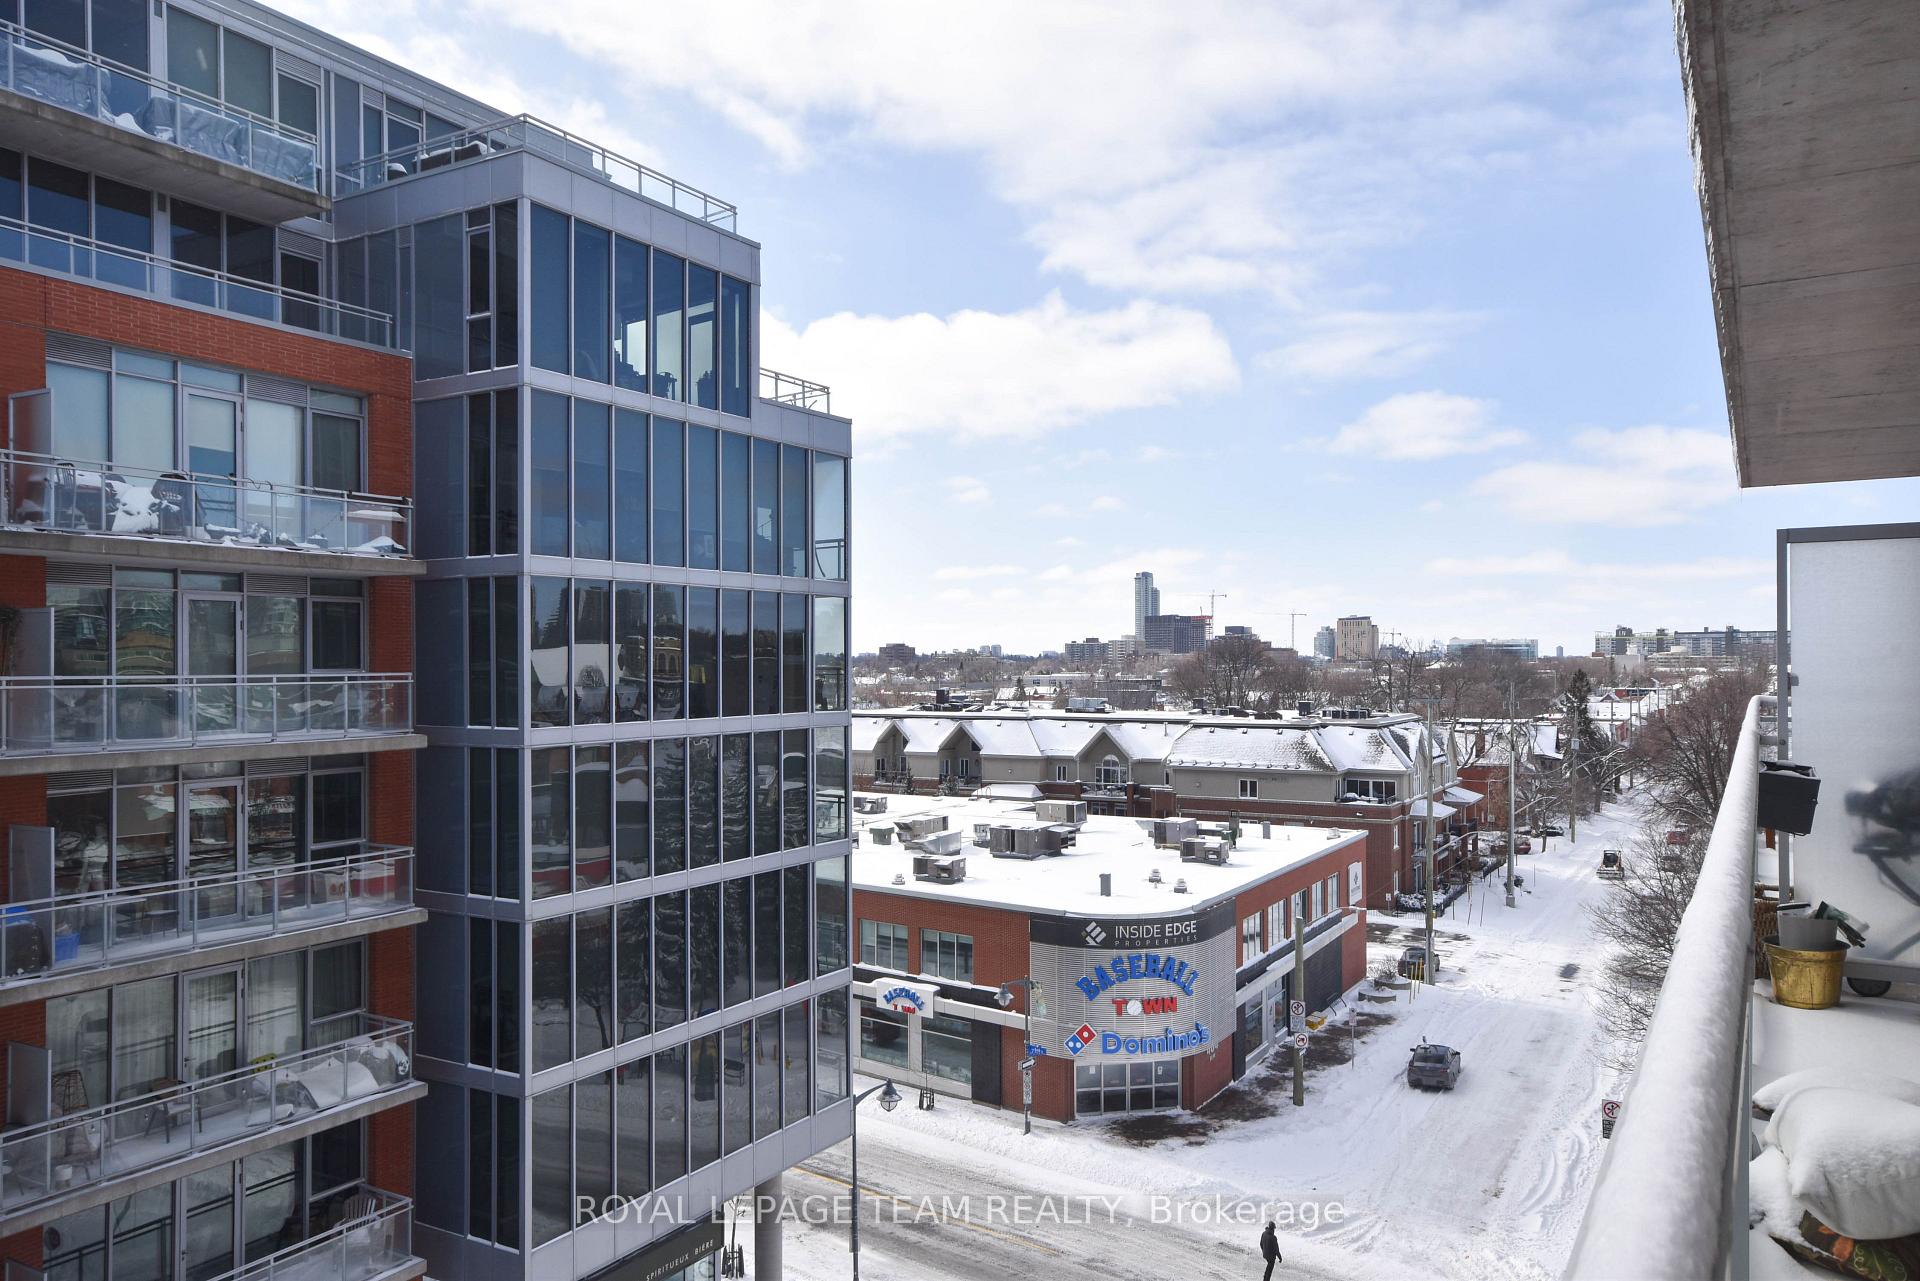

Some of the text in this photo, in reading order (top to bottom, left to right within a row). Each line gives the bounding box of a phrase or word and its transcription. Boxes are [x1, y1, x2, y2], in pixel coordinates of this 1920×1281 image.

[1114, 920, 1197, 939] INSIDE EDGE
[1115, 934, 1198, 947] PROPERTIES
[1075, 953, 1200, 1001] BASEBALL
[1101, 1021, 1212, 1055] Domino's
[646, 1253, 690, 1281] SPIRITUEUX
